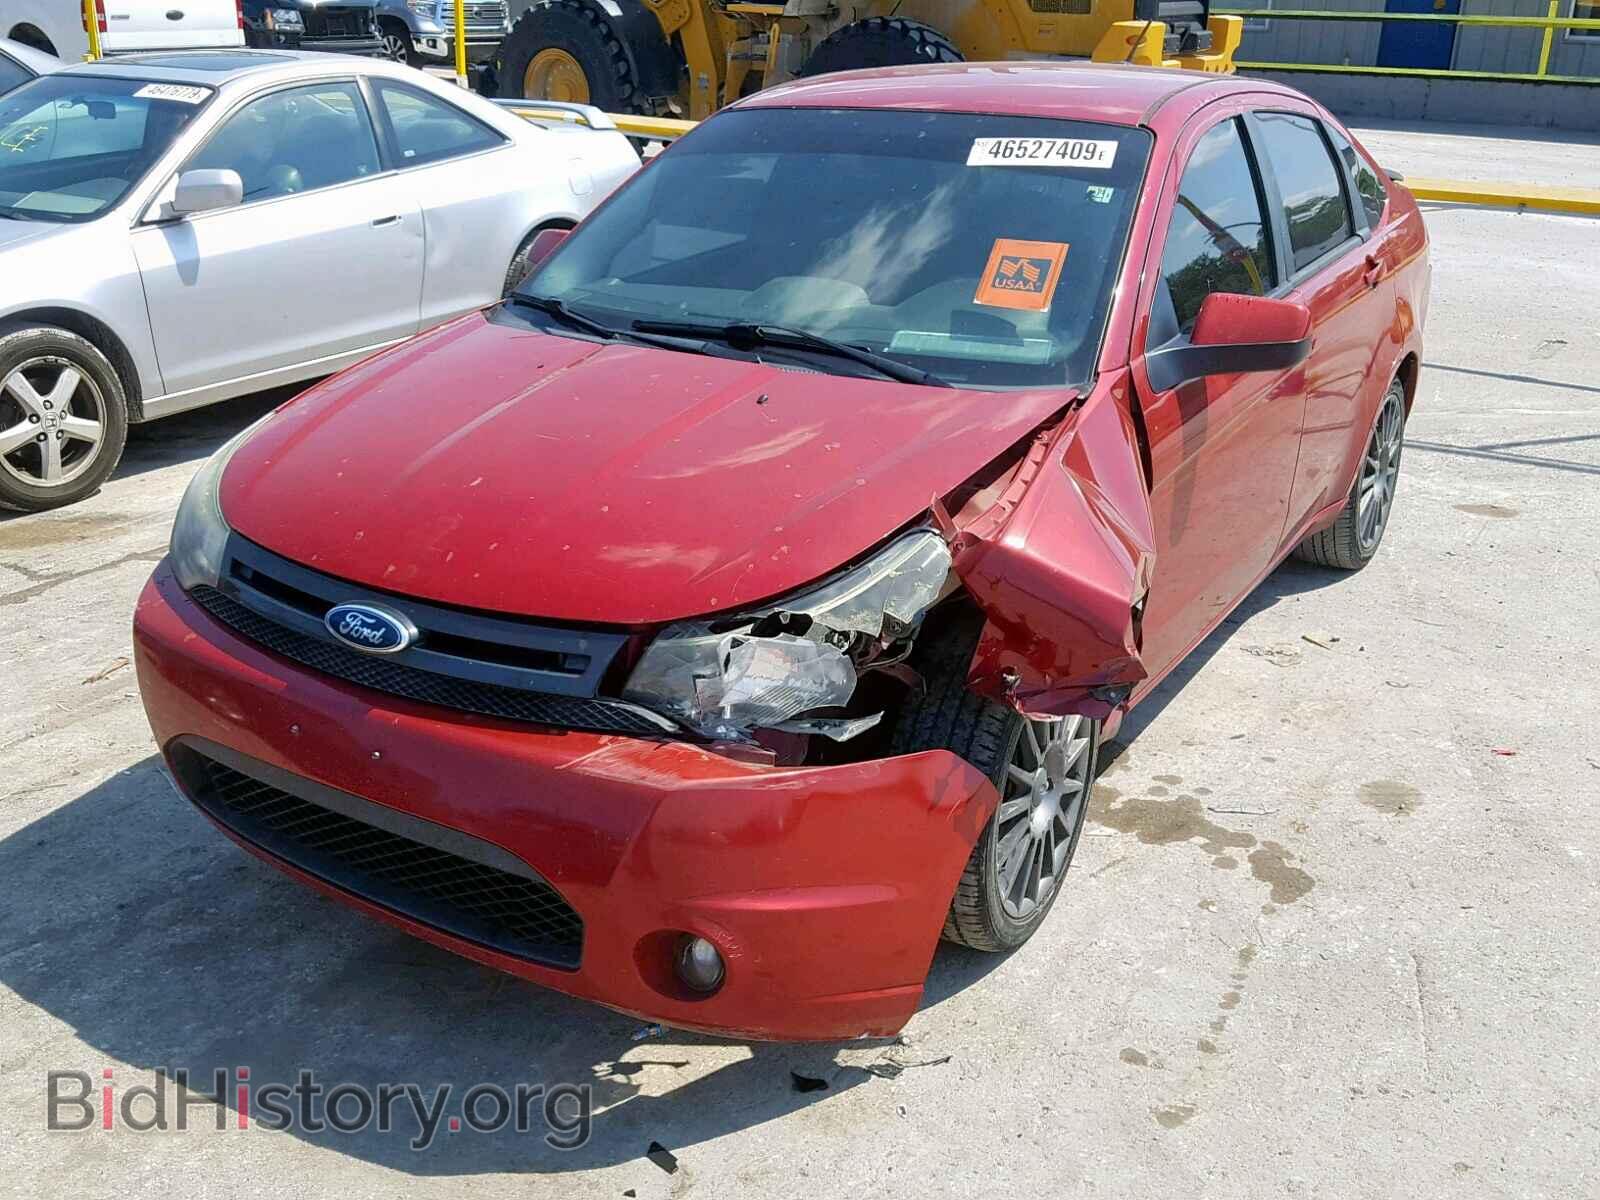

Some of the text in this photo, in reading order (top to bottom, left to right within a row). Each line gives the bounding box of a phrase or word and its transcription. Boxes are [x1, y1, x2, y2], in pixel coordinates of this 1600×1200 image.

[988, 139, 1098, 160] 46527409
[994, 278, 1035, 291] USAA
[339, 612, 386, 645] Ford
